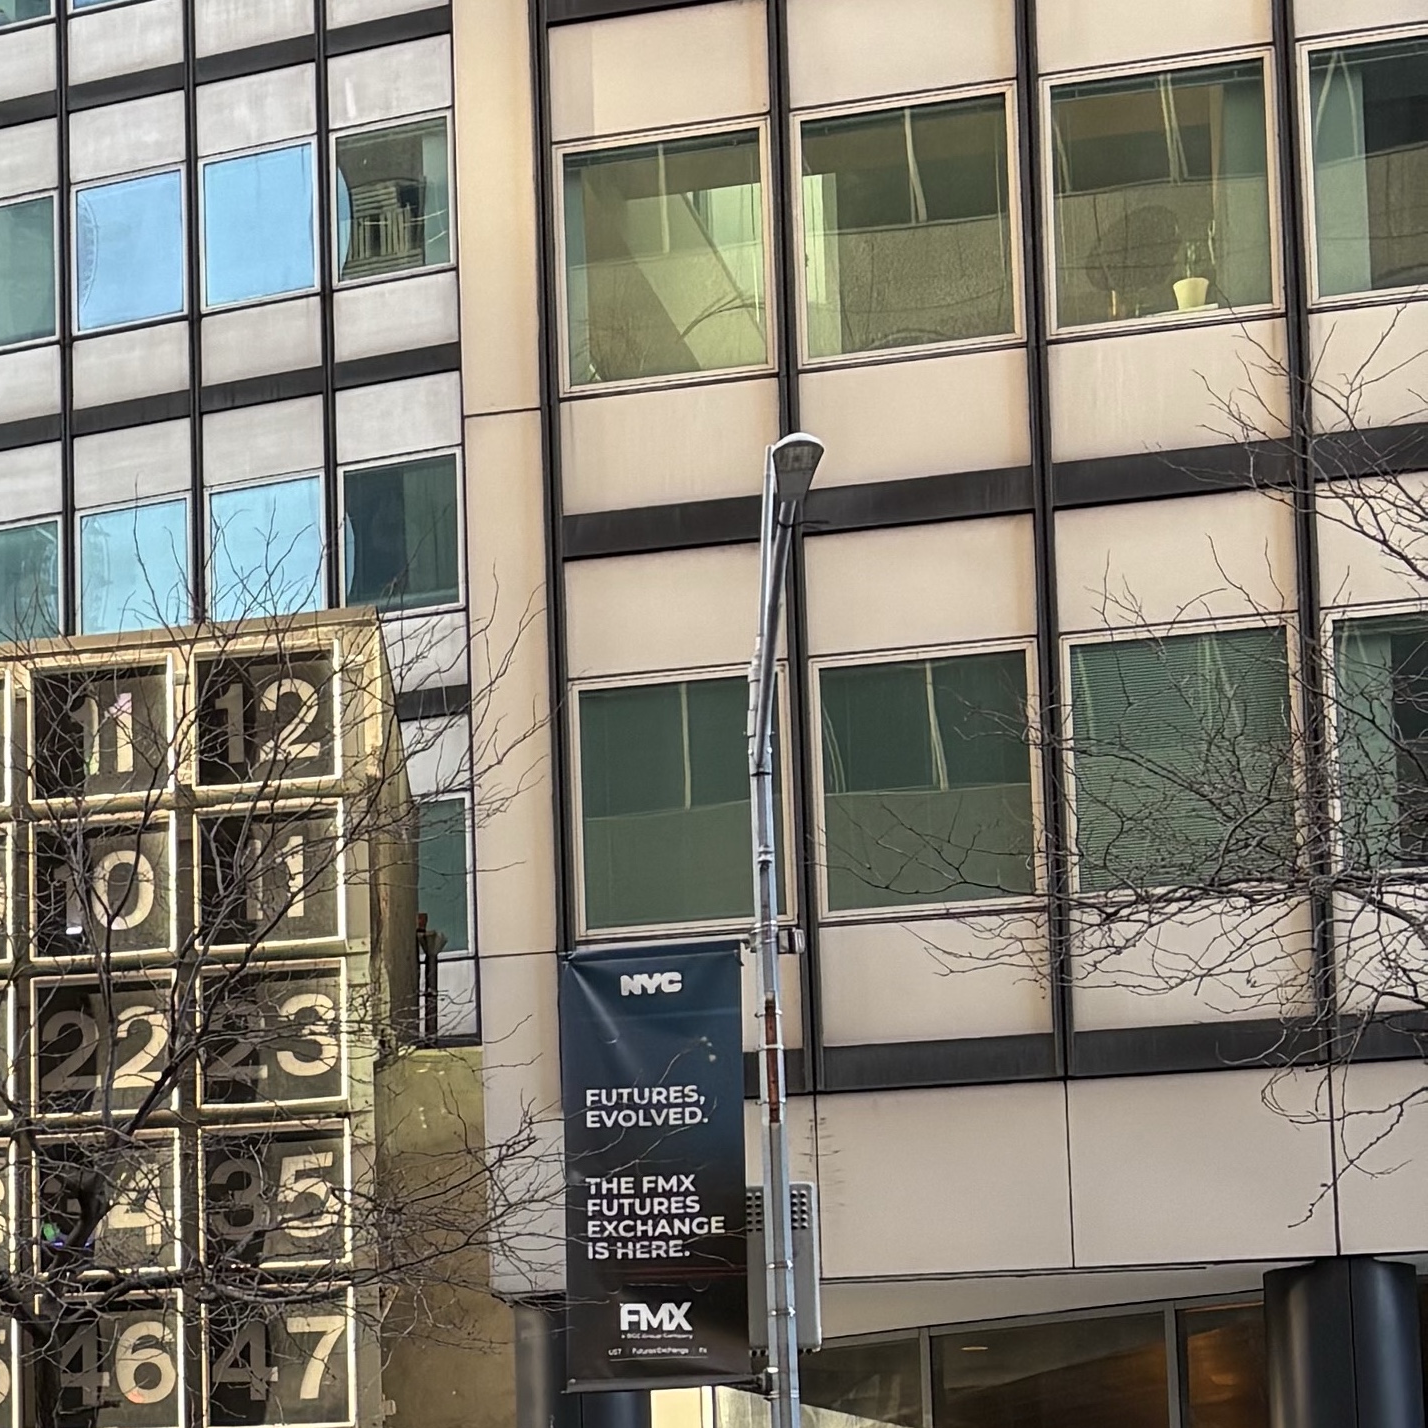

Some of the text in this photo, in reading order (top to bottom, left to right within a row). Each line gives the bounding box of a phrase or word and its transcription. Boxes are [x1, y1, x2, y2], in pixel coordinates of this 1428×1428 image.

[72, 691, 135, 776] 11
[215, 677, 322, 765] 12
[250, 835, 306, 921] 11
[620, 972, 683, 997] NYC
[41, 1003, 170, 1092] 22
[207, 992, 338, 1081] 23
[585, 1085, 706, 1107] FUTURES,
[585, 1107, 709, 1129] EVOLVED.
[207, 1150, 343, 1240] 35
[586, 1174, 696, 1196] THE FMX
[587, 1195, 700, 1217] FUTURES
[587, 1216, 726, 1238] EXCHANGE
[587, 1239, 691, 1260] IS HERE.
[620, 1302, 693, 1331] FMX
[61, 1321, 178, 1403] 46
[215, 1316, 345, 1399] 47
